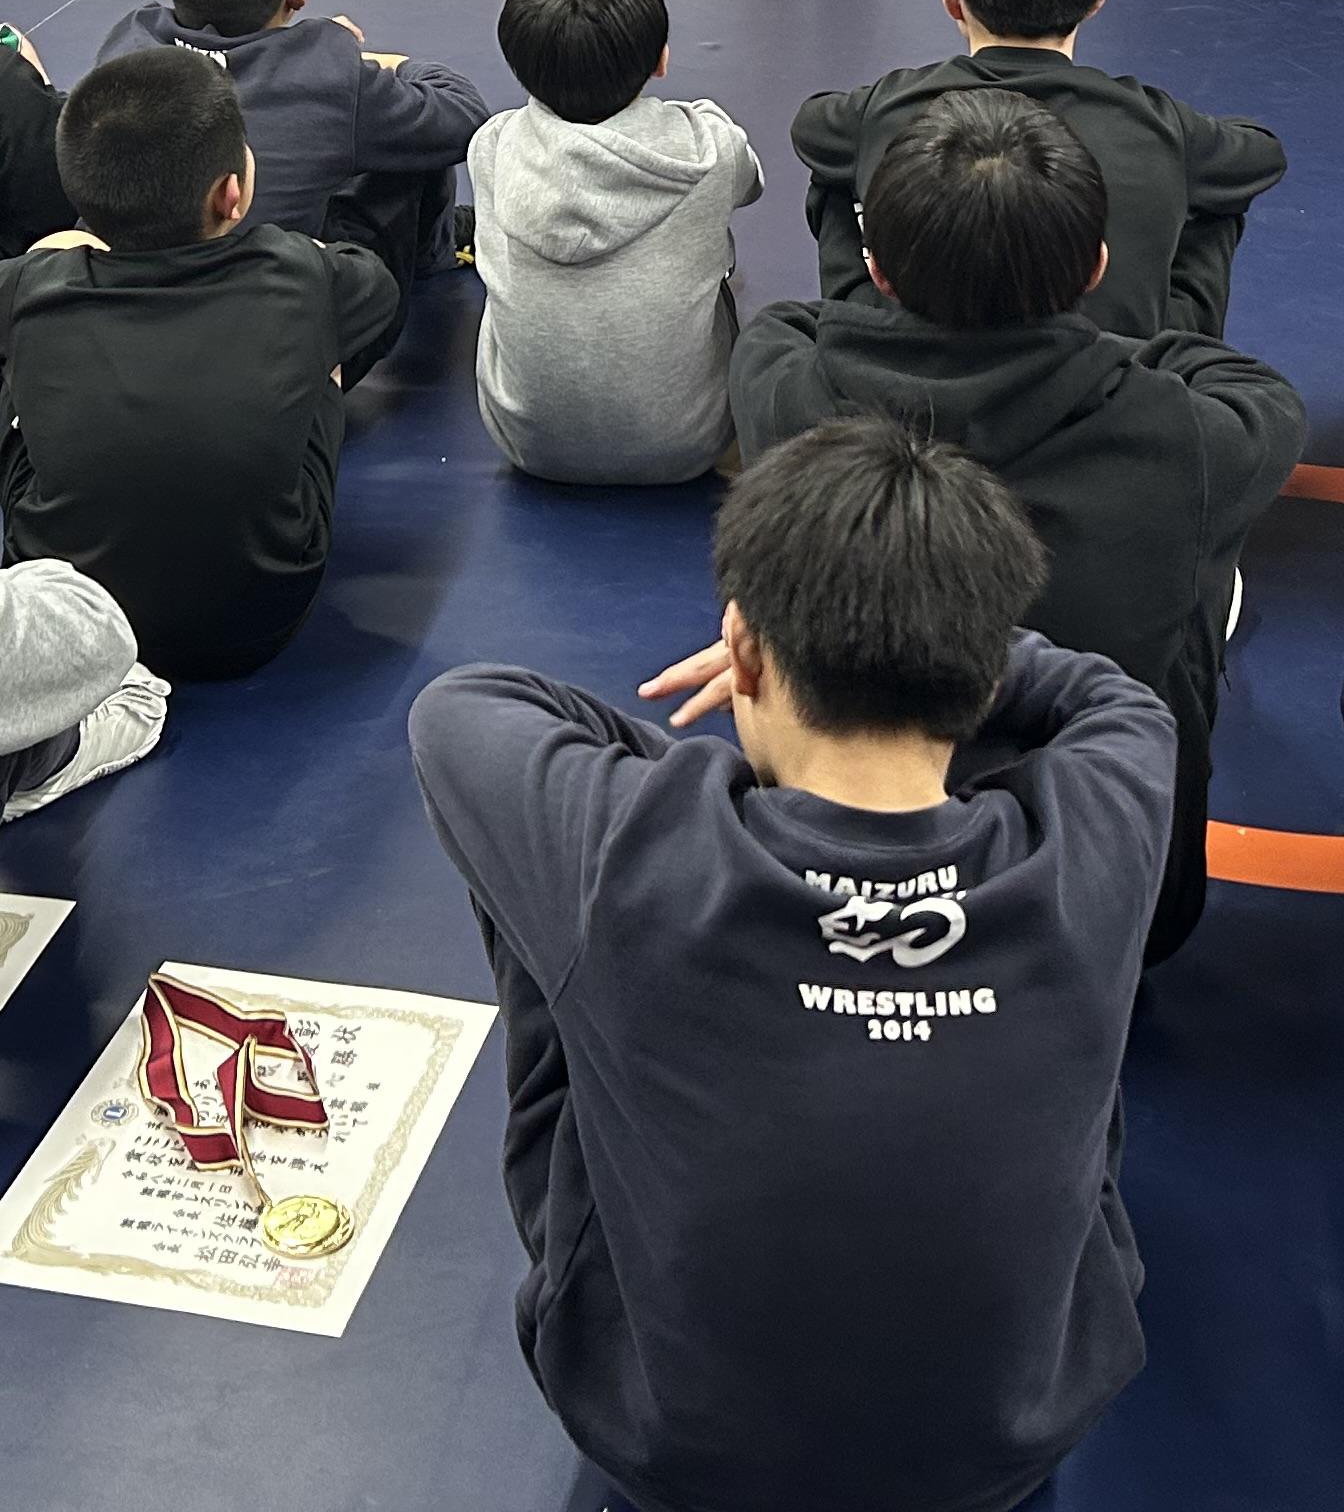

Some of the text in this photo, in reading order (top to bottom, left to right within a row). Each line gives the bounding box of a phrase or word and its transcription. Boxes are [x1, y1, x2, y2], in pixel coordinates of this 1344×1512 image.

[805, 865, 958, 899] MAIZURU
[798, 984, 997, 1016] WRESTLING
[867, 1019, 931, 1041] 2014
[140, 1186, 265, 1215] 舞鶴市レスリング
